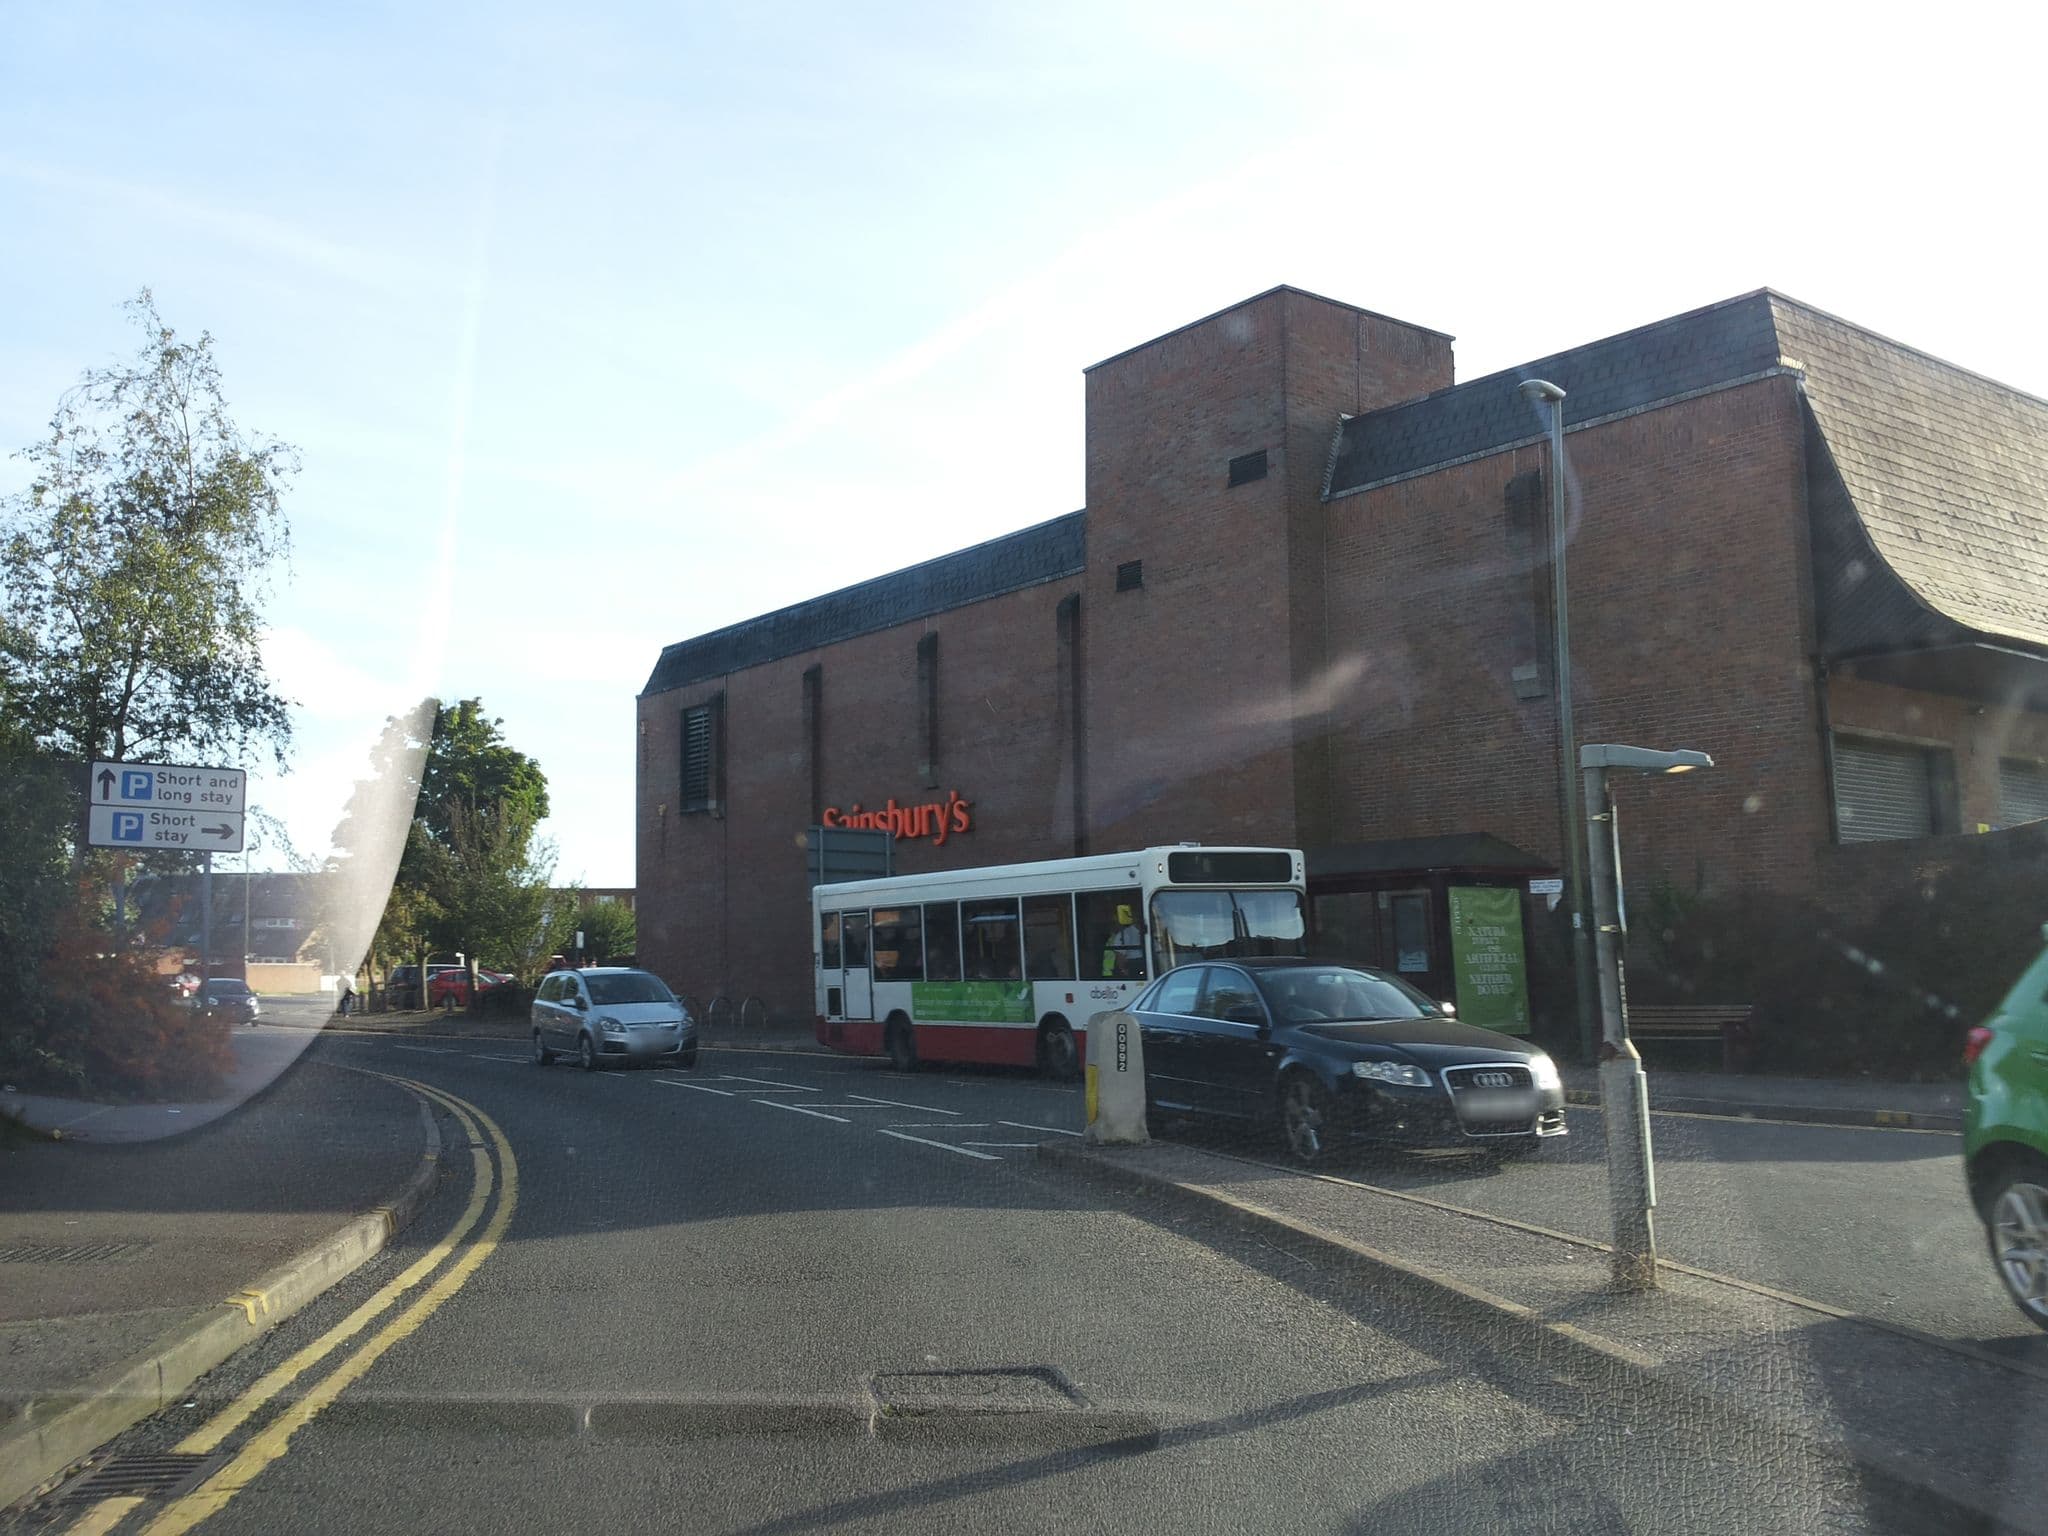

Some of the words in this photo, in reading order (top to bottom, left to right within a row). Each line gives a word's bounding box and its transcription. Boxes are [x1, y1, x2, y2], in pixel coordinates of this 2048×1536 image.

[128, 774, 148, 797] P
[156, 771, 202, 786] Short
[209, 777, 238, 789] and
[157, 788, 192, 804] long
[200, 790, 233, 805] stay
[119, 815, 139, 838] P
[150, 812, 196, 827] Short
[154, 829, 189, 844] stay
[1118, 1024, 1127, 1071] 00992
